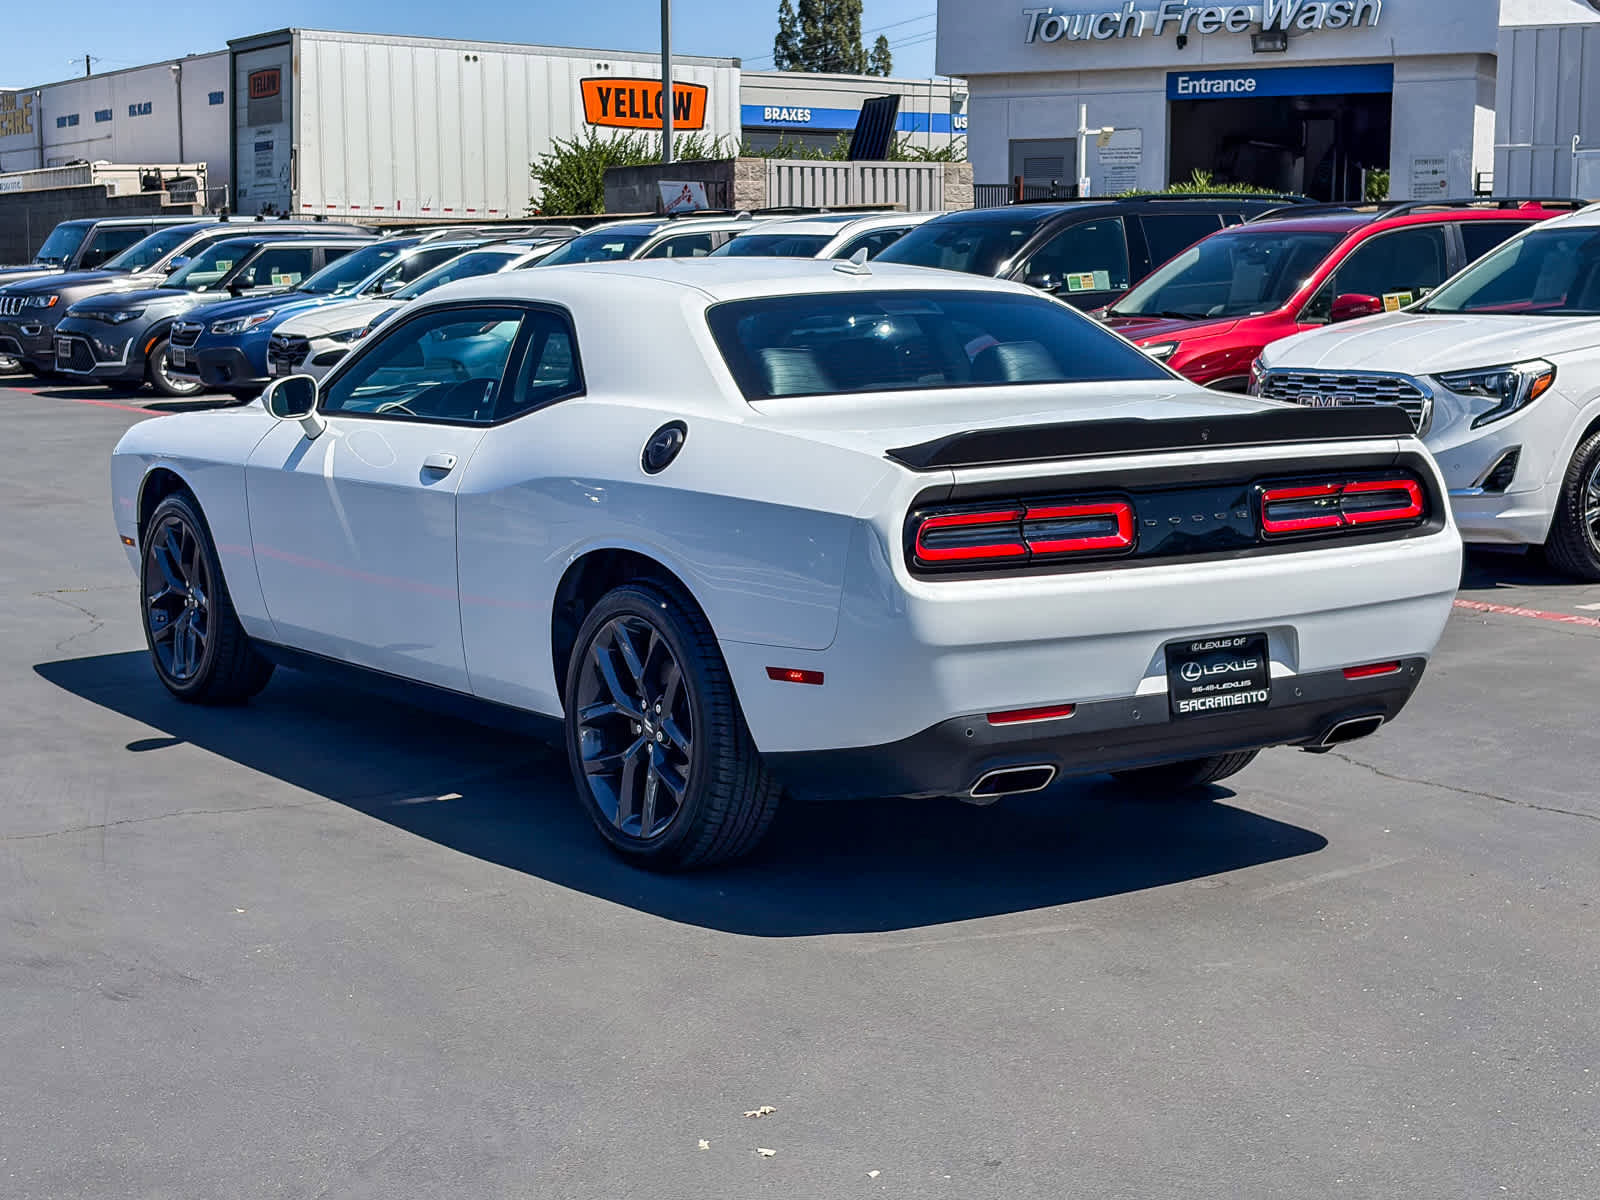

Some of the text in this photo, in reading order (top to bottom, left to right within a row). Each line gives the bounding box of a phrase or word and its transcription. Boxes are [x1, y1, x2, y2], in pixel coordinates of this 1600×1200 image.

[1023, 0, 1382, 44] Touch Free Wash
[1177, 76, 1257, 95] Entrance
[764, 107, 811, 122] BRAKES
[1200, 637, 1247, 650] LEXUS OF
[1203, 659, 1258, 675] LEXUS
[1180, 690, 1268, 713] SACRAMENTO
